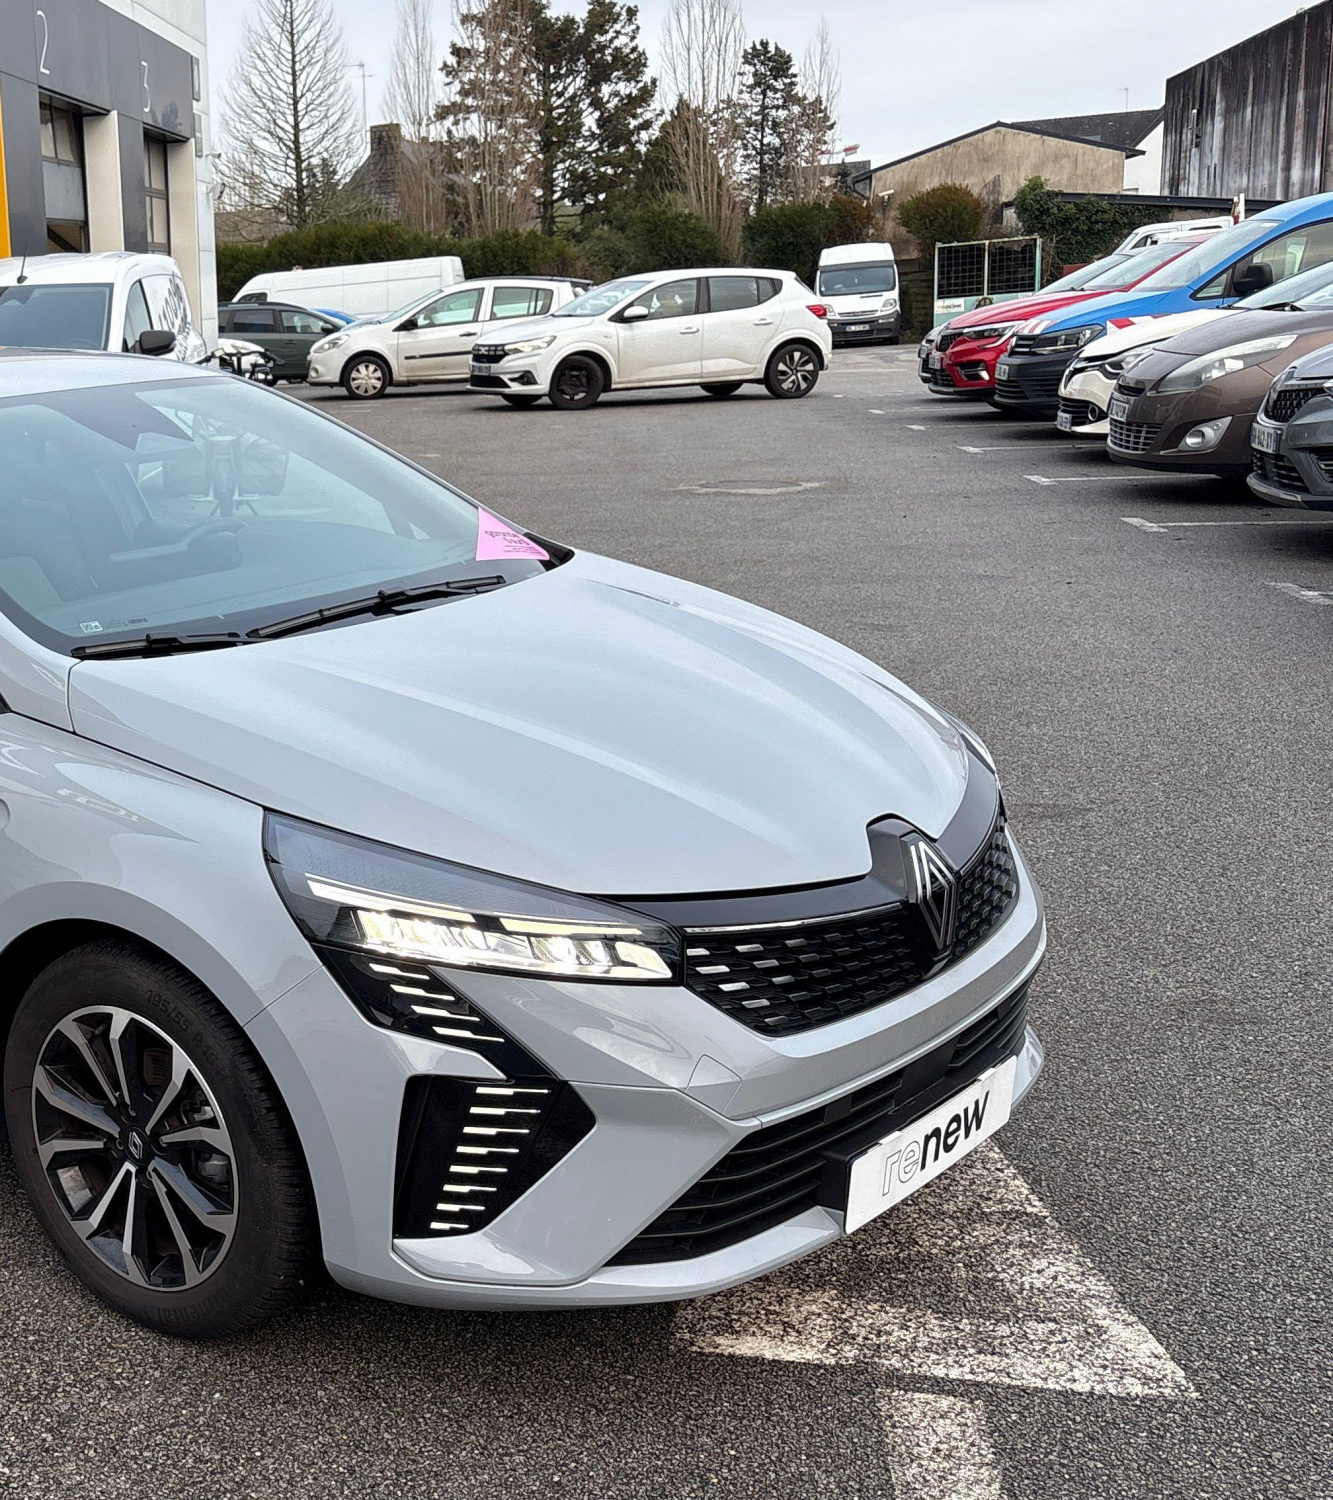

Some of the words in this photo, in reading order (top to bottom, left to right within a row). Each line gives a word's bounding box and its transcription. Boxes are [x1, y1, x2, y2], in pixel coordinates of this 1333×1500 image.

[36, 10, 50, 75] 2
[140, 60, 151, 113] 3
[881, 1089, 991, 1197] renew
